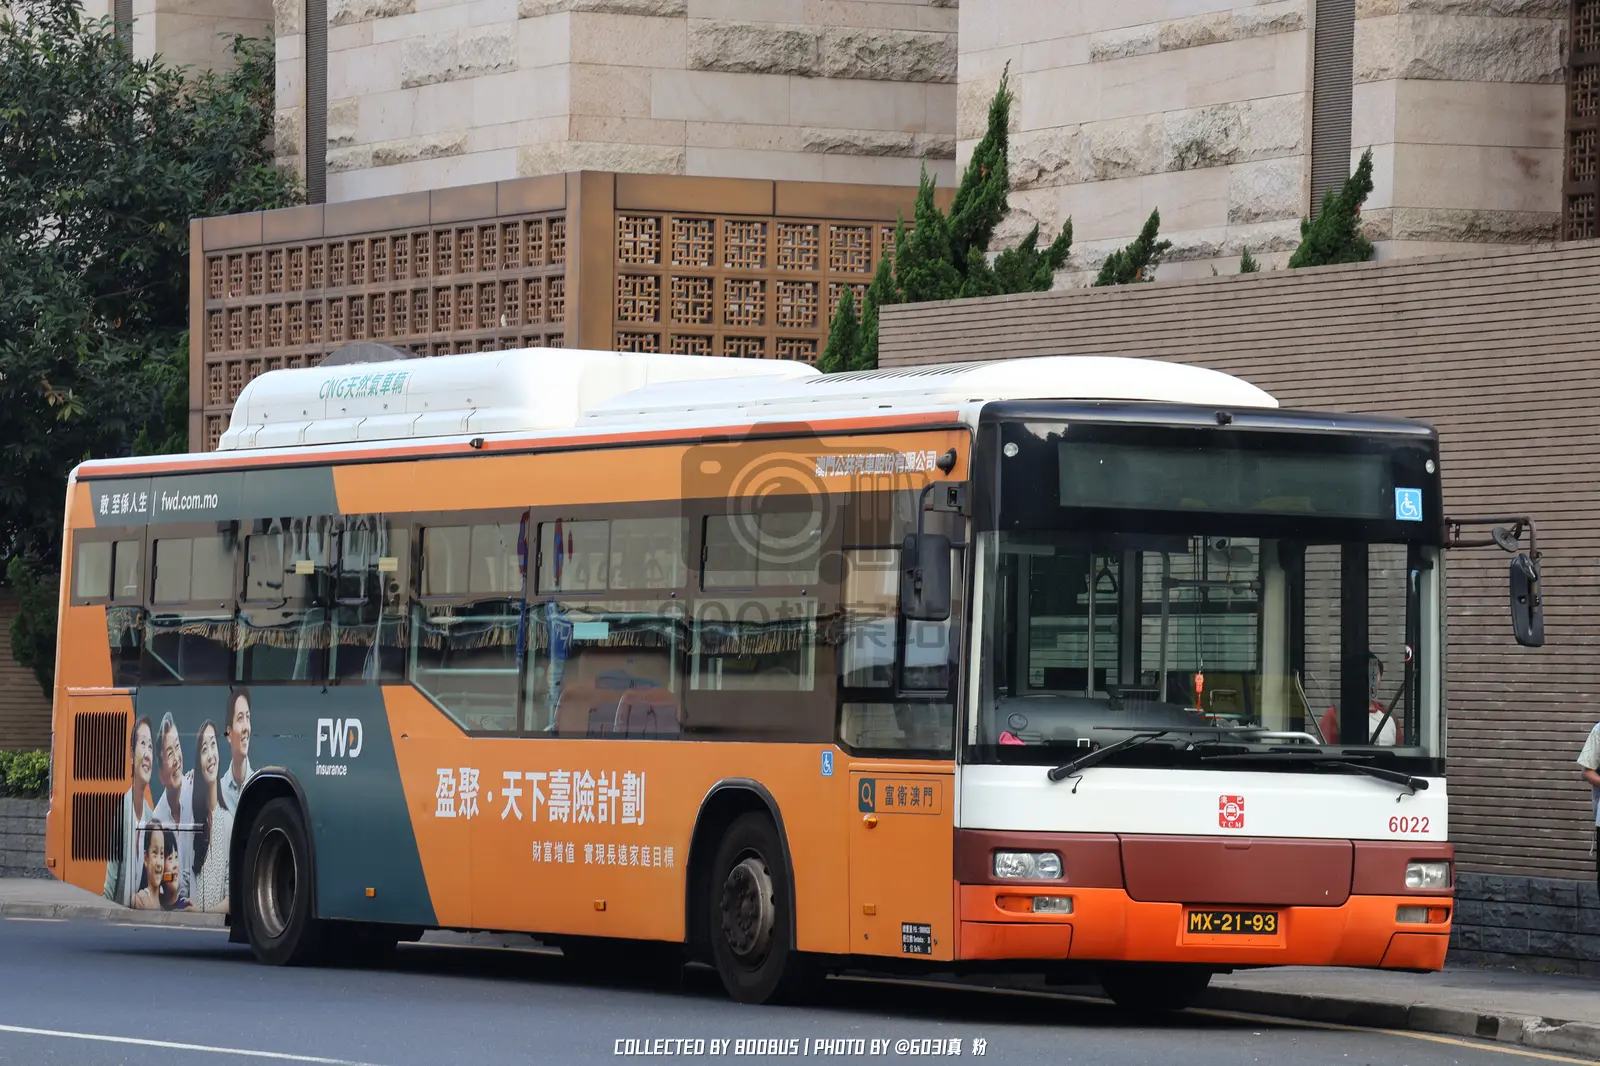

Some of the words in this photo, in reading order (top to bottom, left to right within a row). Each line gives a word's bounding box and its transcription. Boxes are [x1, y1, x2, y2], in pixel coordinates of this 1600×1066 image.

[100, 494, 110, 516] 敢
[111, 491, 148, 515] 至係人生
[161, 490, 219, 511] fwd.com.mo
[316, 718, 363, 758] FWD
[315, 760, 348, 776] insurance
[884, 785, 934, 808] 富衛澳門
[1388, 816, 1430, 833] 6022
[532, 840, 576, 864] 財富增值
[584, 842, 675, 869] 實現長遠家庭目標
[1190, 913, 1276, 932] MX-21-93
